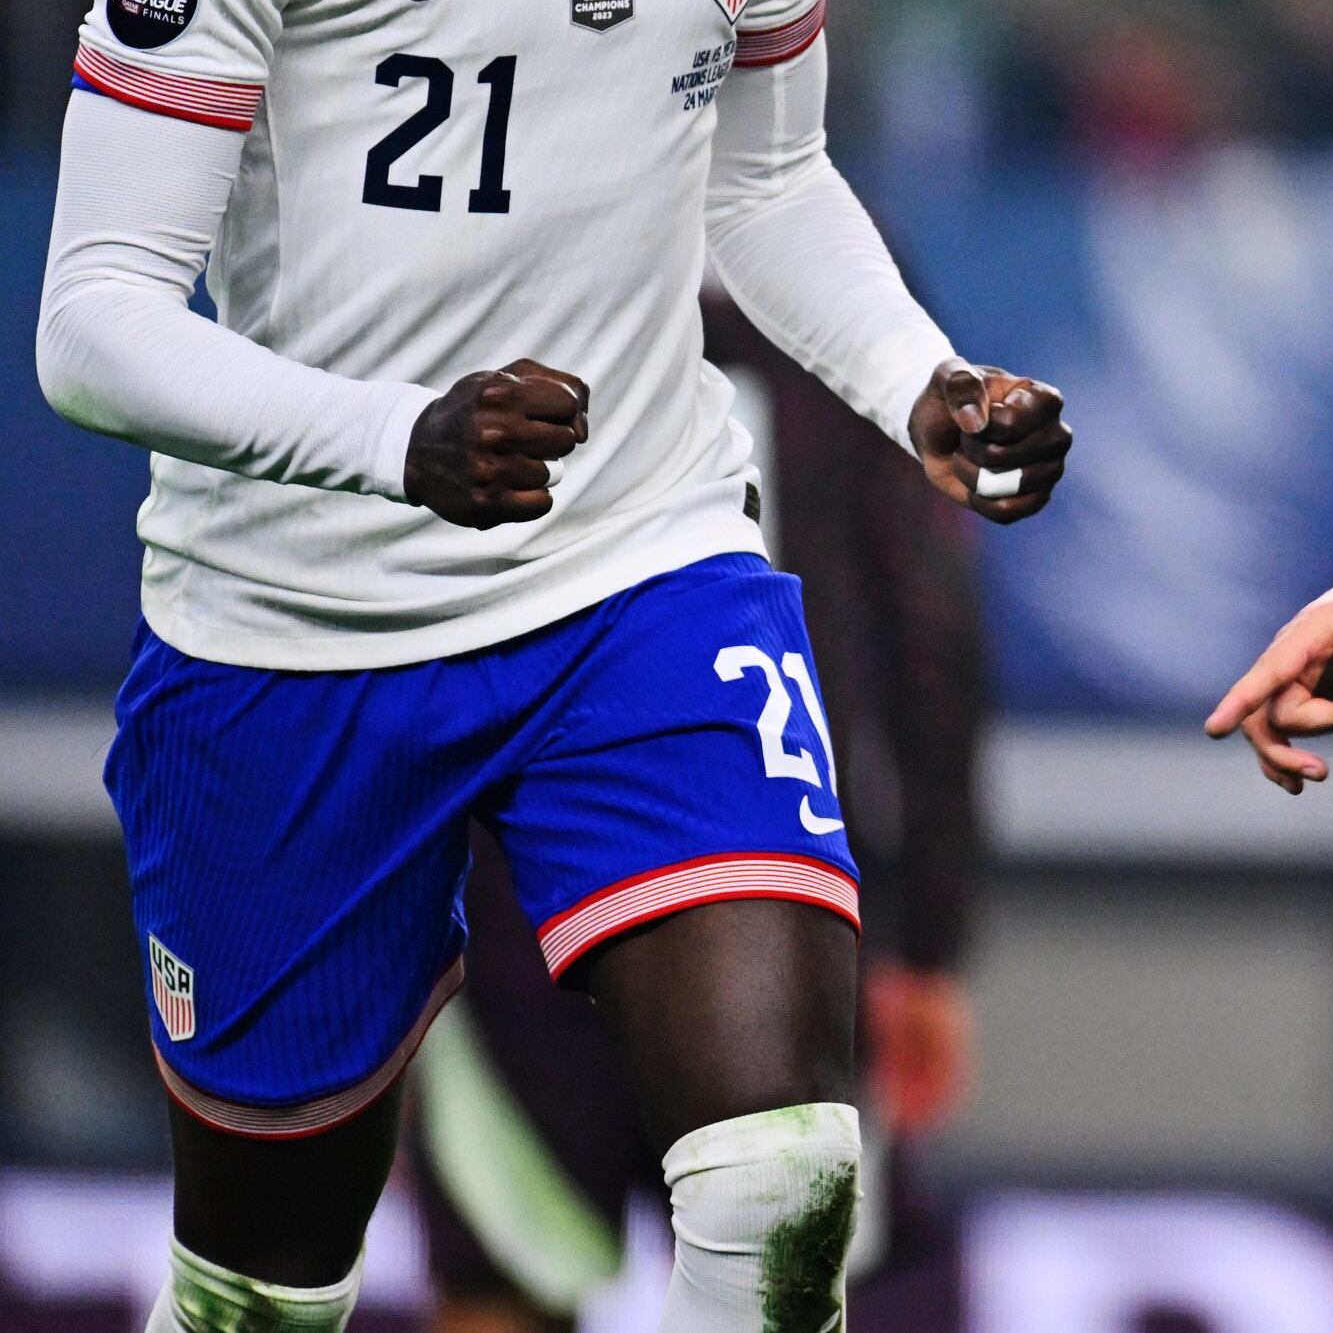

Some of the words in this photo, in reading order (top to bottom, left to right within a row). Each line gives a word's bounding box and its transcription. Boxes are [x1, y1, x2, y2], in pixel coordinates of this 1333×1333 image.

[143, 7, 185, 25] FINALS
[592, 10, 613, 21] 2023
[683, 92, 696, 111] 24
[361, 53, 517, 214] 21
[713, 644, 838, 798] 21
[151, 941, 191, 994] USA
